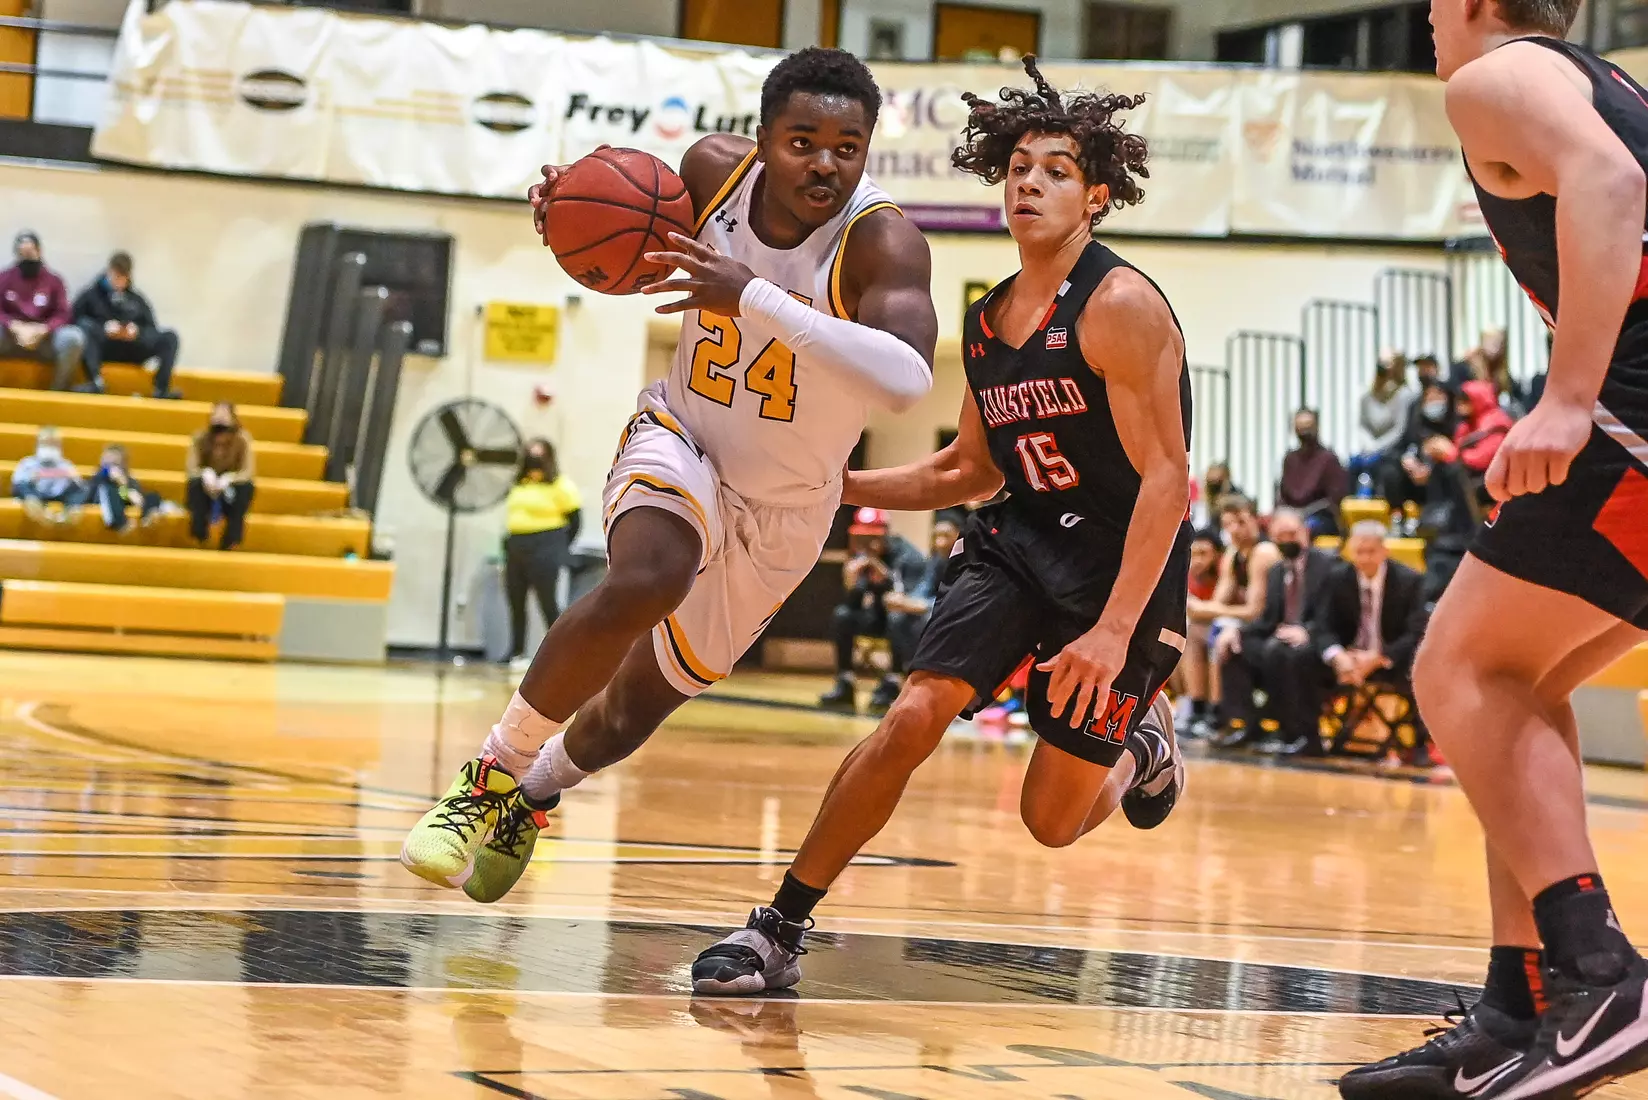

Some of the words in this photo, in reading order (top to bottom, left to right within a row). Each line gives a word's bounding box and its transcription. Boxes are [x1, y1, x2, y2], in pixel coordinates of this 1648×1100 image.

[565, 93, 650, 134] Frey
[694, 104, 758, 135] Lut
[687, 309, 798, 423] 24
[1047, 333, 1067, 343] PSAC
[1015, 431, 1080, 491] 15
[1084, 689, 1139, 746] M
